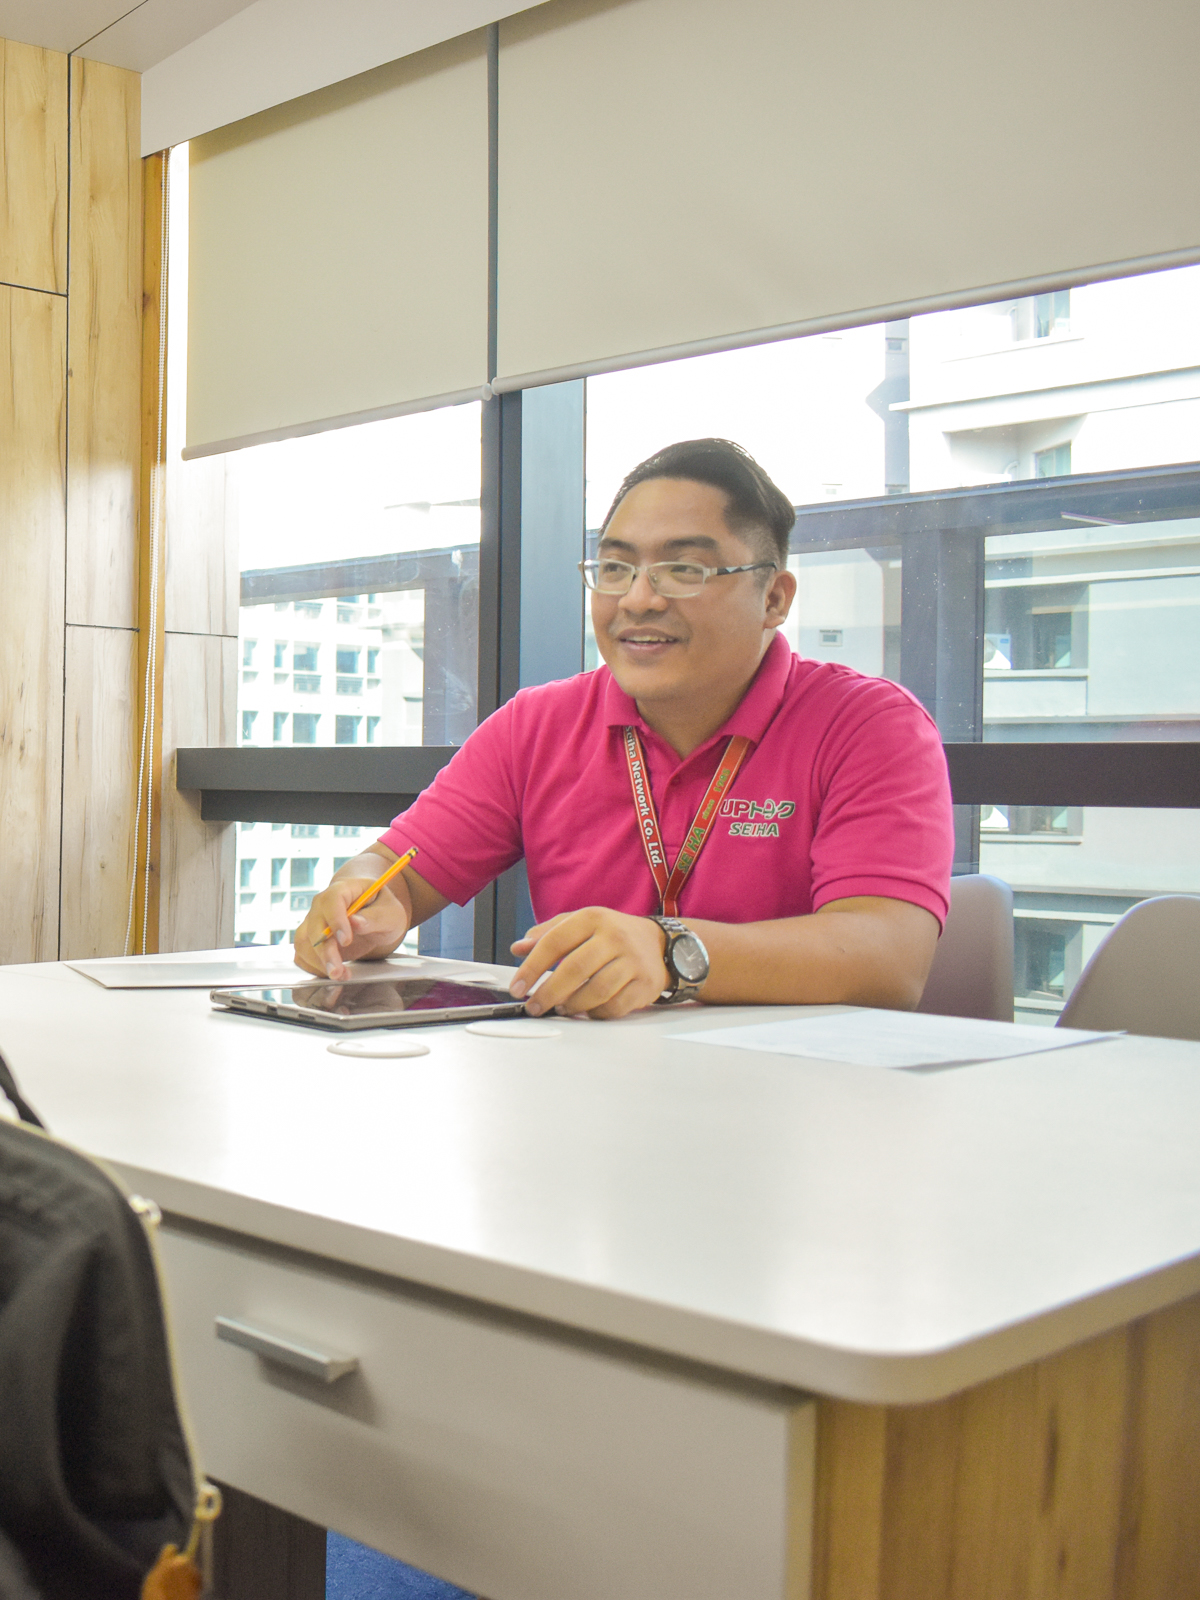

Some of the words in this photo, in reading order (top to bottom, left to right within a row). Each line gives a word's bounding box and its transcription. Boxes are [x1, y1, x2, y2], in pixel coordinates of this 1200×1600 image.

[625, 725, 637, 758] Seiha
[631, 761, 649, 816] Network
[643, 818, 654, 840] Co.
[729, 822, 779, 837] SEIHA
[648, 842, 662, 867] Ltd.
[677, 826, 705, 873] SEIHA
